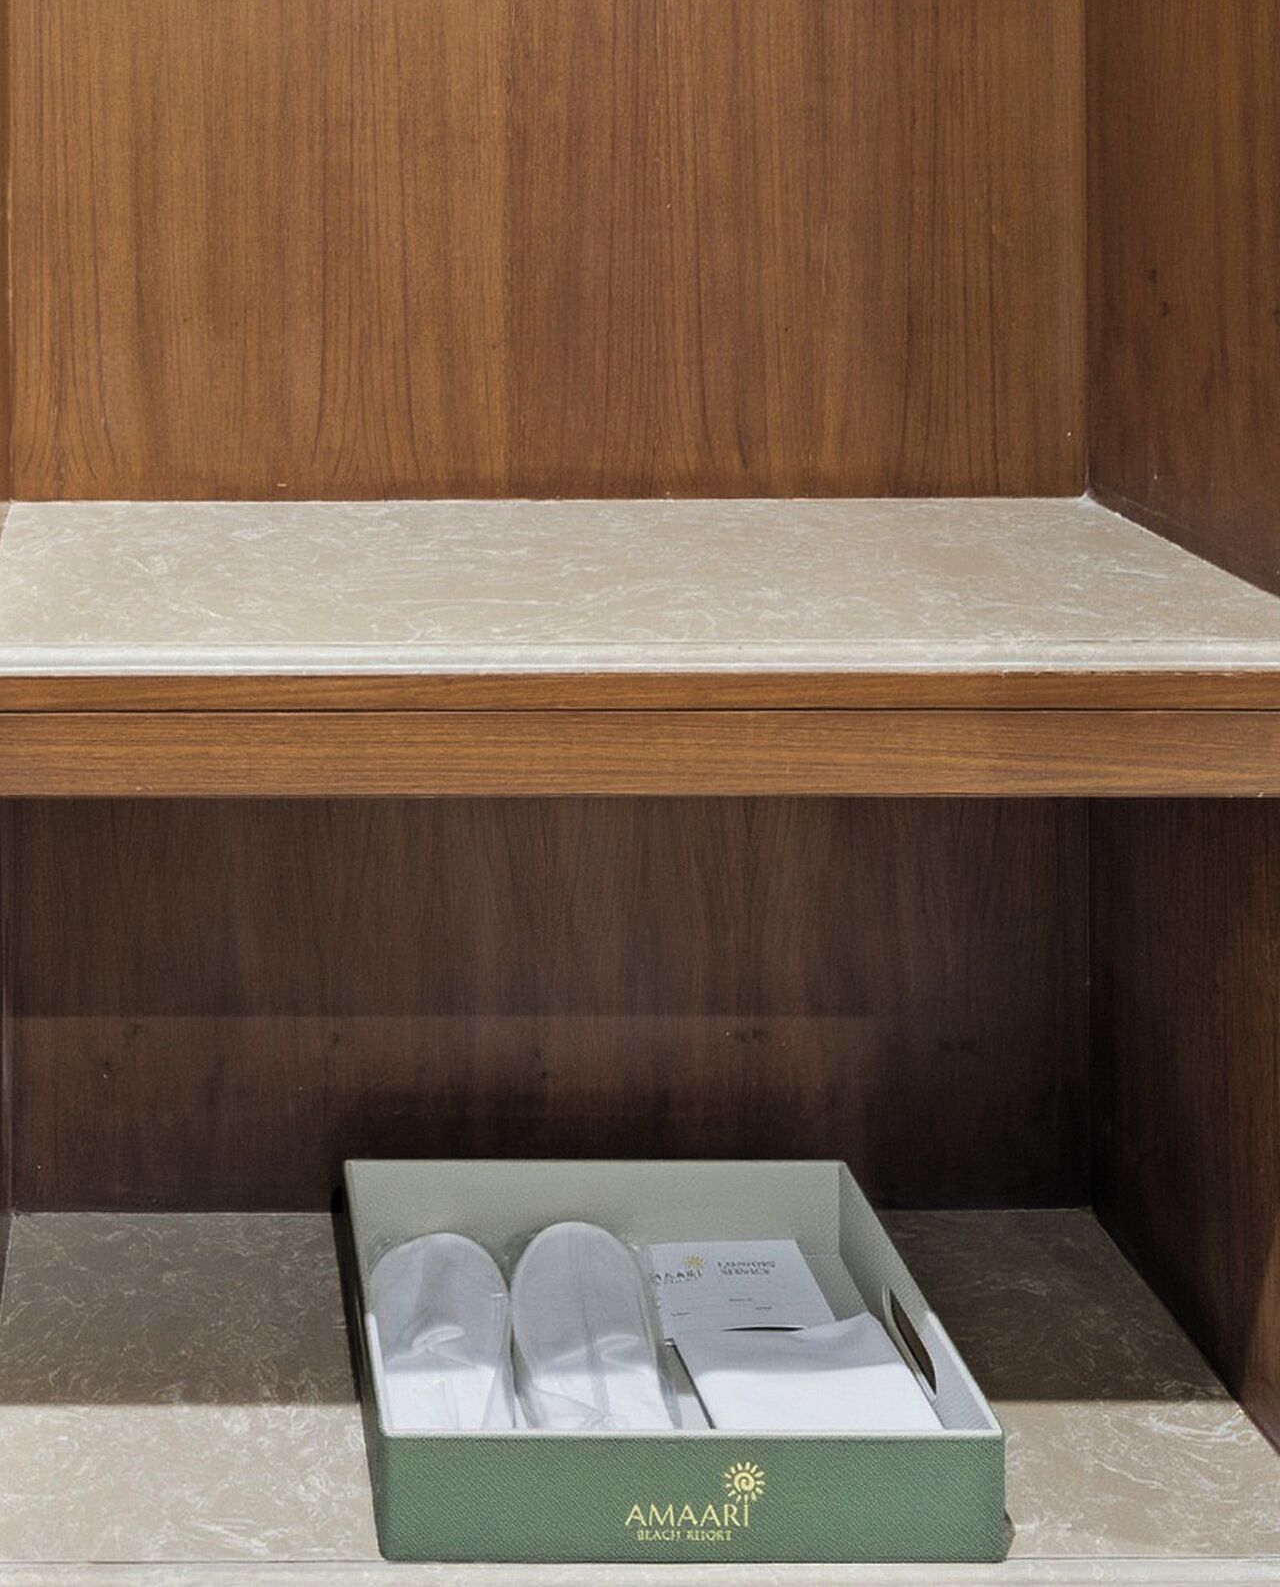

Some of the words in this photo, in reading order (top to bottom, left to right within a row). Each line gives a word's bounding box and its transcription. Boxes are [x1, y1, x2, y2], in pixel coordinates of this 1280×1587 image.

[625, 1500, 750, 1528] AMAARI
[636, 1529, 680, 1542] BEACH
[687, 1529, 733, 1542] RESORT
